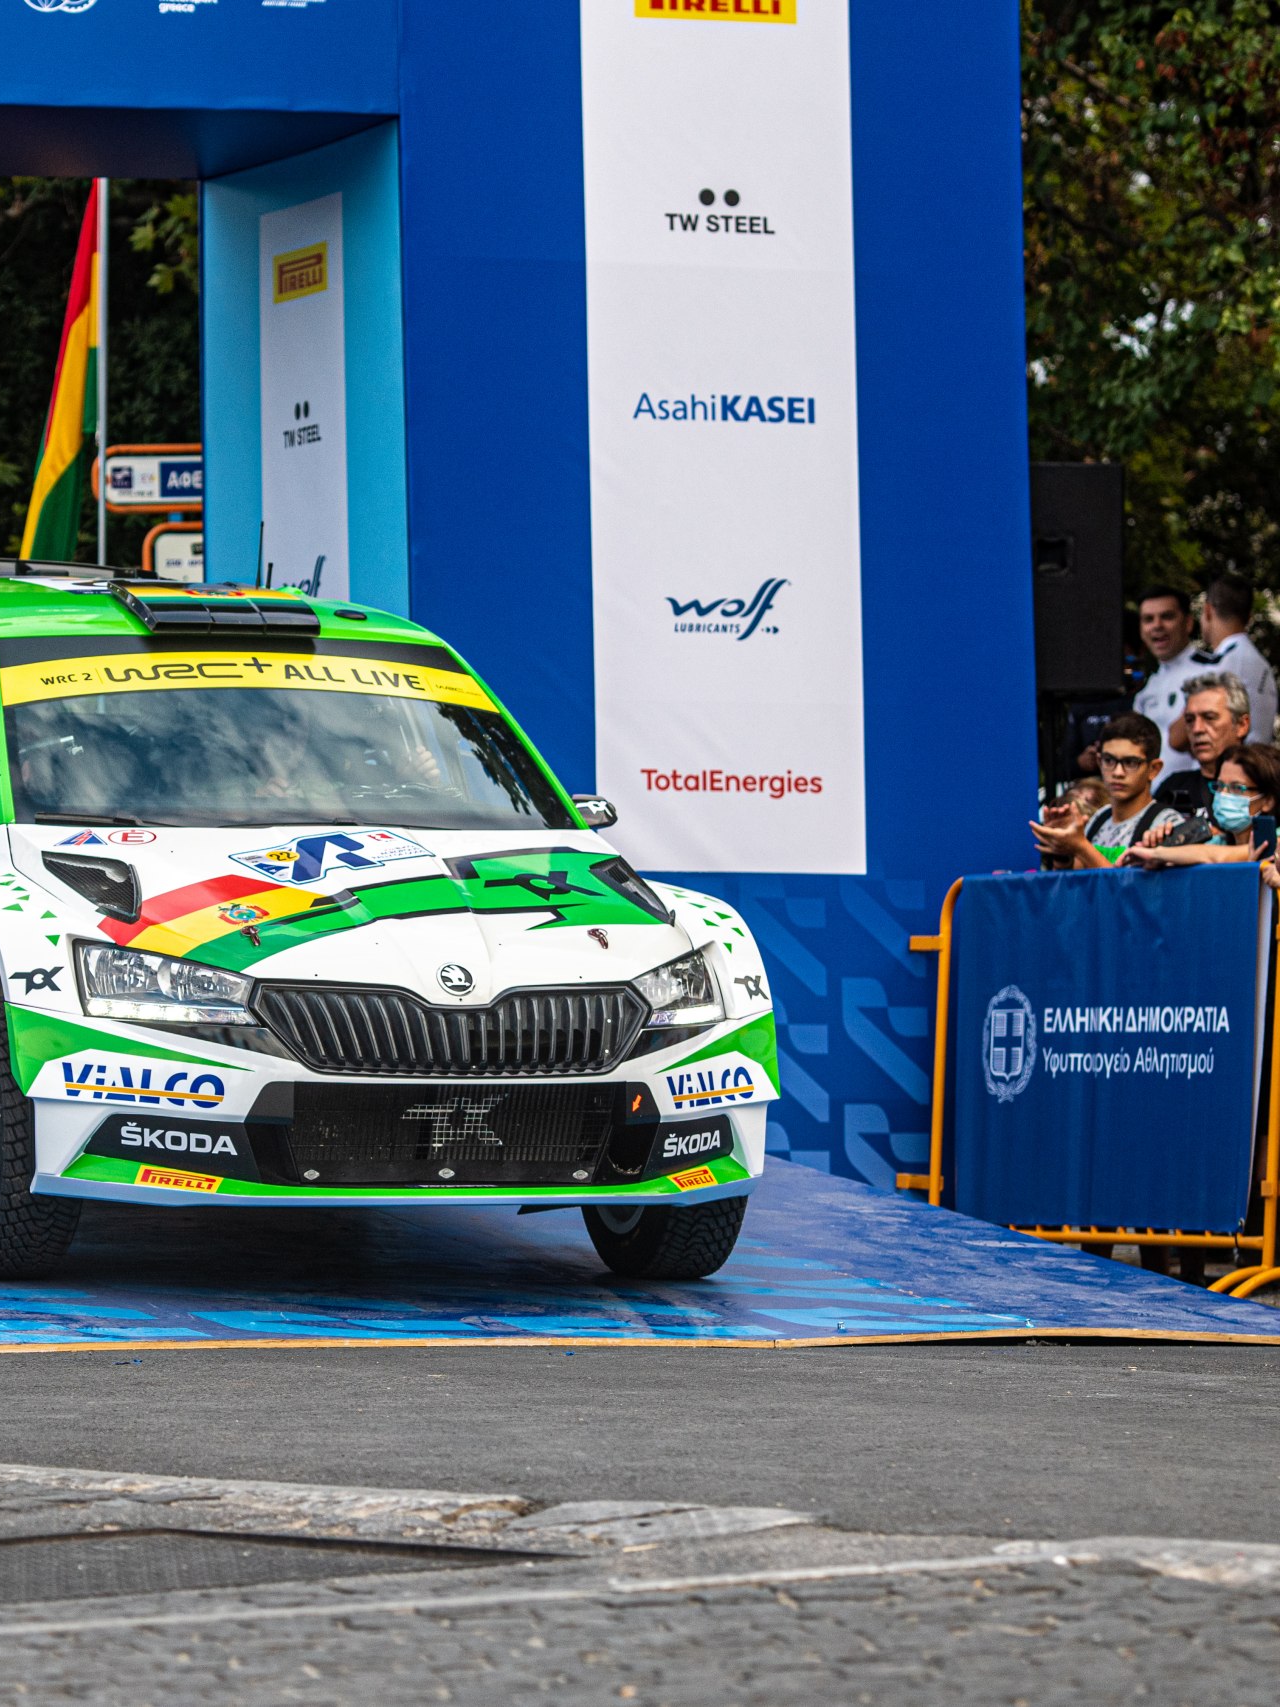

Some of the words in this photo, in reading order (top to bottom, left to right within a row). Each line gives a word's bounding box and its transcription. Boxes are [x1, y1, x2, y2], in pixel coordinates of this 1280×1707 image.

[664, 213, 699, 232] TW
[705, 214, 776, 235] STEEL
[277, 252, 323, 295] PIRELLI
[297, 423, 322, 446] STEEL
[664, 577, 792, 641] wolf
[673, 622, 741, 634] LUBRICANTS
[40, 672, 78, 686] WRC
[81, 672, 93, 681] 2
[284, 664, 346, 684] ALL
[351, 668, 426, 692] LIVE
[641, 768, 823, 799] TotalEnergies
[267, 849, 298, 863] 22
[1124, 1006, 1230, 1034] ΔΗΜΟΚΡΑΤΙΑ
[1133, 1047, 1215, 1080] Αθλητισμού
[120, 1121, 238, 1156] ŠKODA
[663, 1130, 721, 1158] ŠKODA
[139, 1168, 218, 1191] PIRELLI
[673, 1170, 715, 1189] PIRELLI
